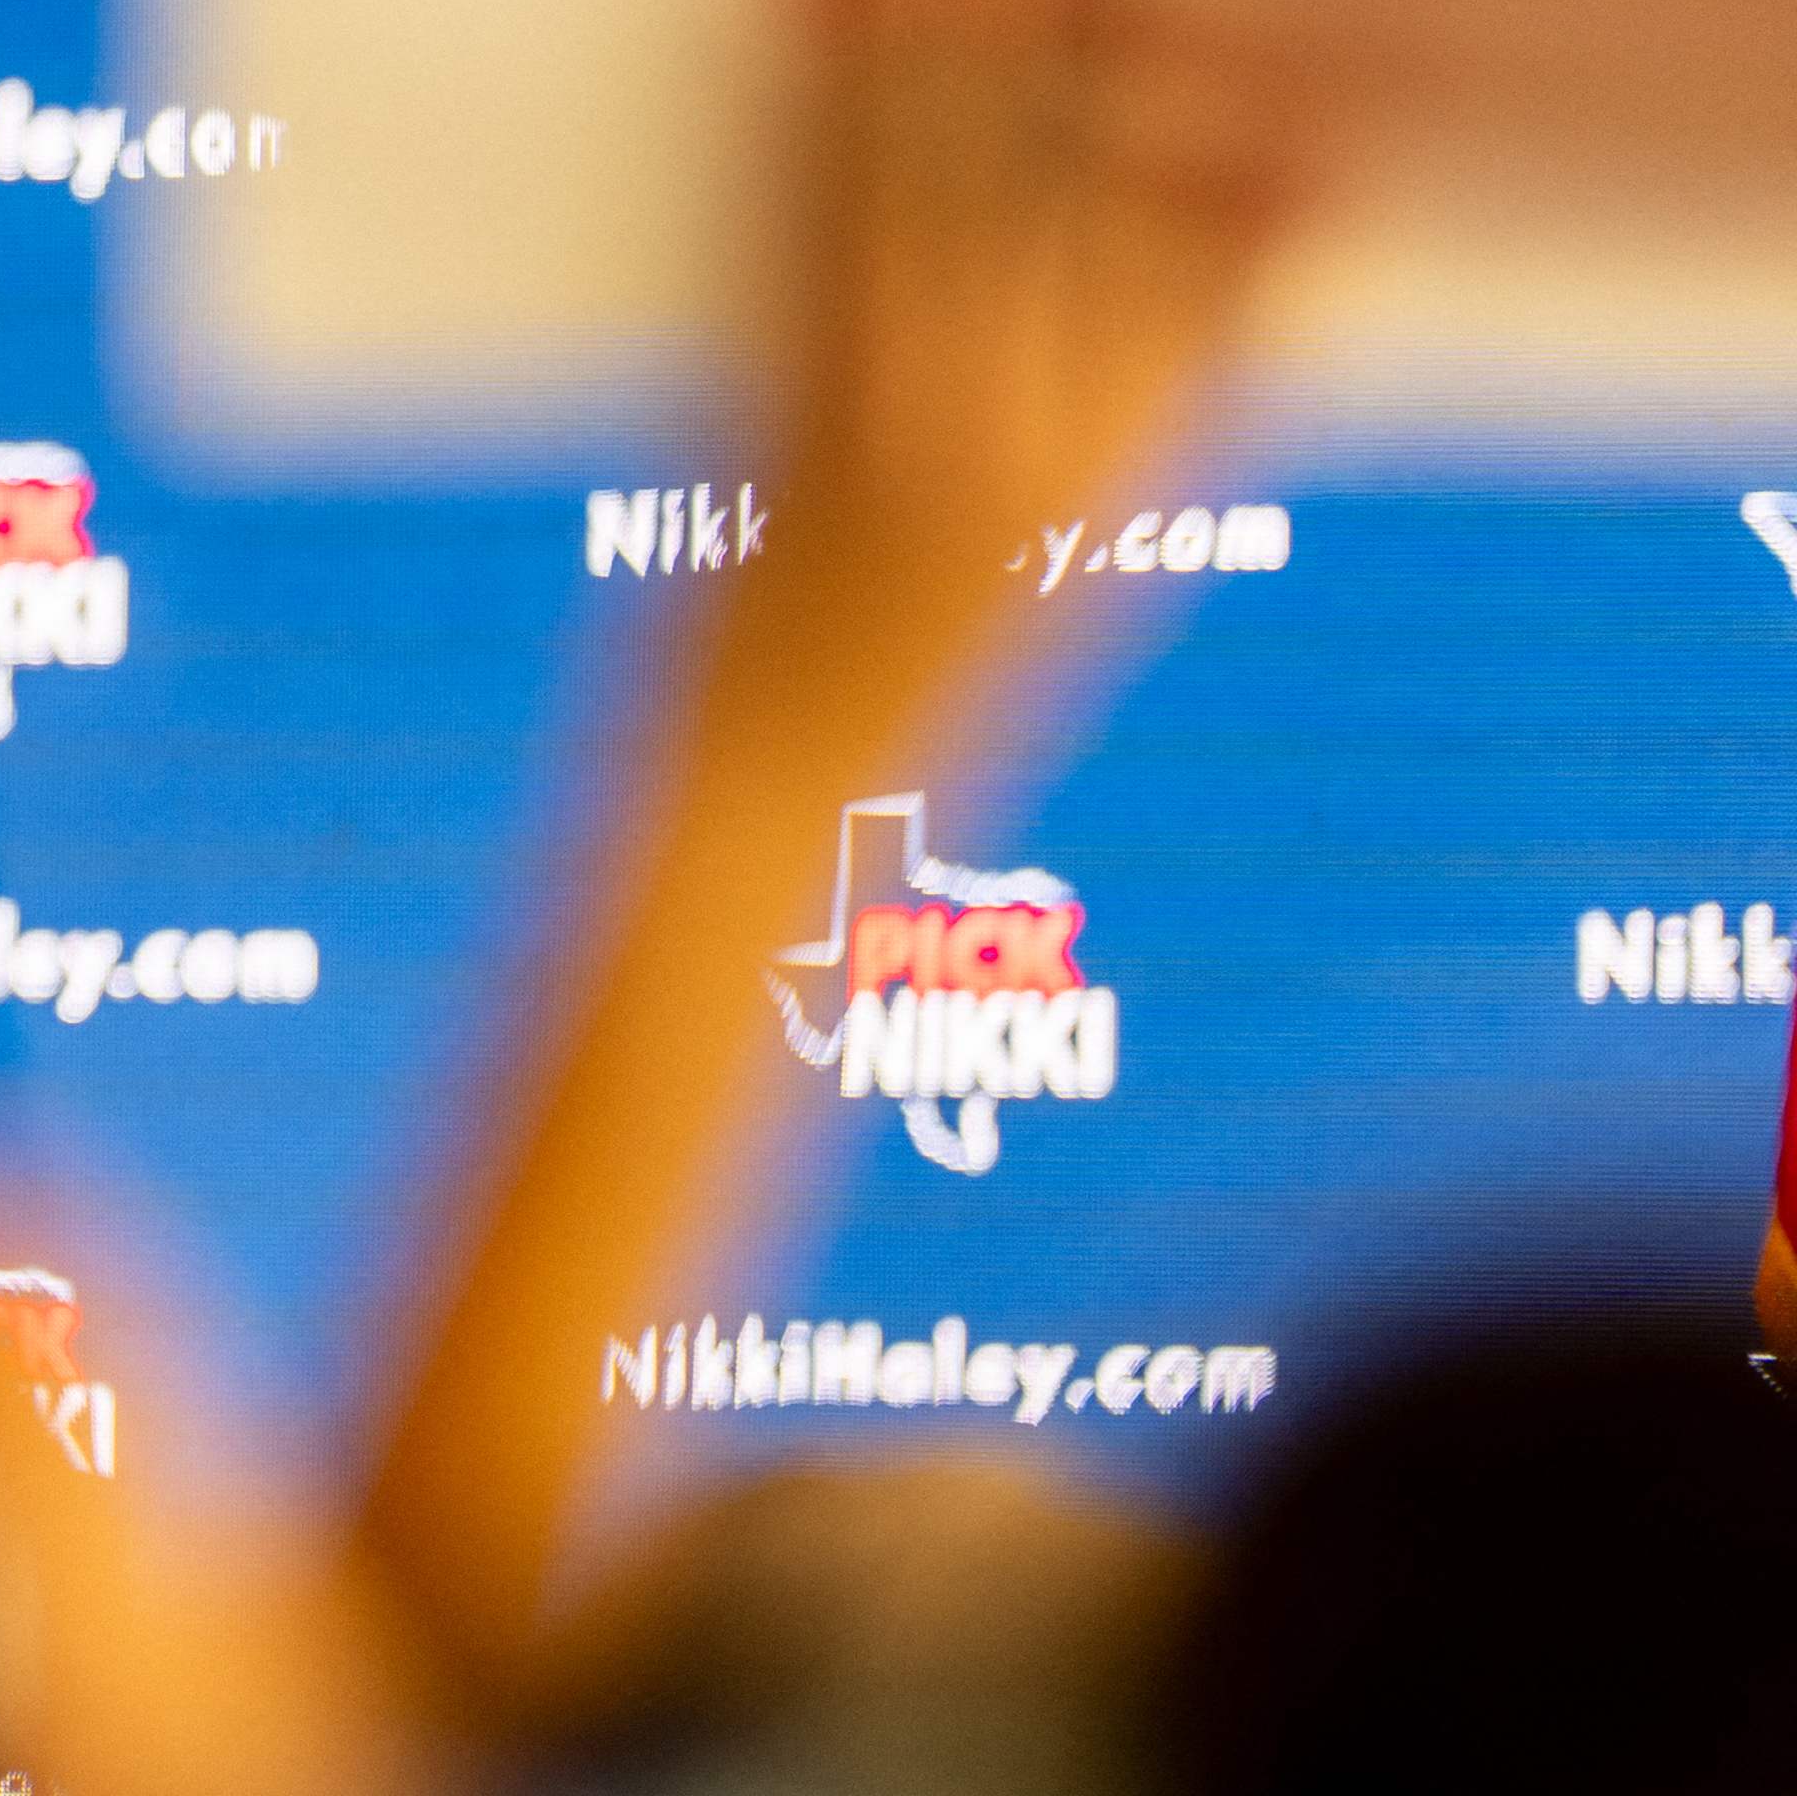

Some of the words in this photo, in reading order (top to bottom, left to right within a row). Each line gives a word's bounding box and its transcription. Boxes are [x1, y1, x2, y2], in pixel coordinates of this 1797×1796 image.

[586, 482, 1291, 596] Nikky.com
[847, 904, 1087, 997] PICK
[841, 987, 1118, 1097] NIKKI
[603, 1313, 1279, 1426] NikkiHaley.com
